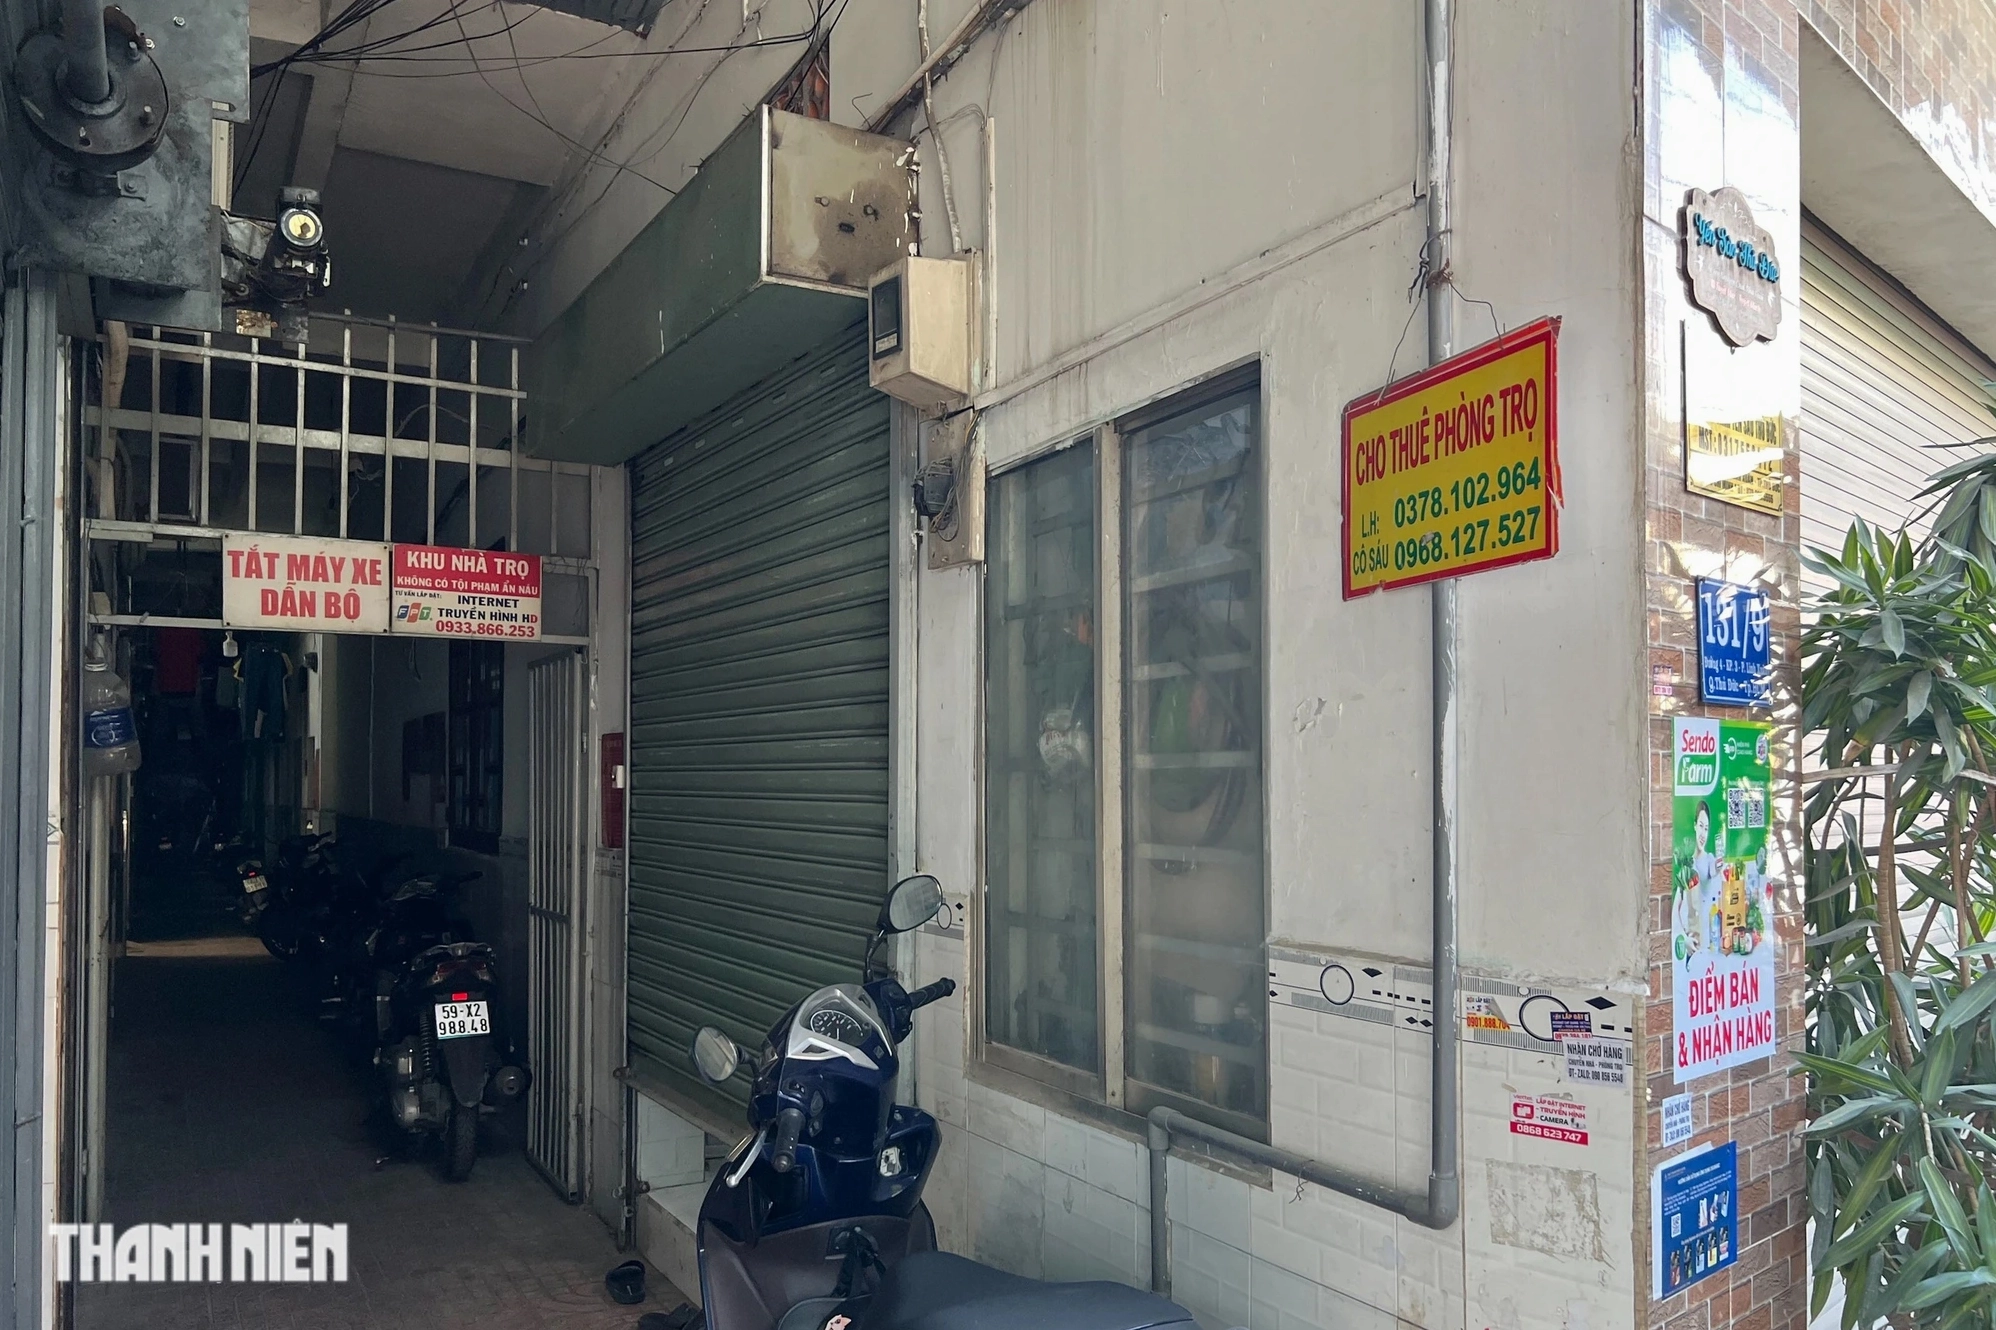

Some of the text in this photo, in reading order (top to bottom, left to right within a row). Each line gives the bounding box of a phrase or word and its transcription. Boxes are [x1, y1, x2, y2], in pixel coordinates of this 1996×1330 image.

[1356, 378, 1538, 486] CHO THUÊ PHÒNG TRỌ
[1361, 456, 1541, 538] L.H: 0378.102.964
[1353, 505, 1541, 576] CÔ SÁU 0968.127.527
[227, 544, 382, 586] TẮT MÁY XE
[407, 551, 529, 580] KHU NHÀ TRỌ
[397, 574, 538, 595] KHÔNG CÓ TỘI PHẠM ẨN NÁU
[261, 581, 361, 624] DẪN BỘ
[457, 595, 520, 608] INTERNET
[397, 603, 538, 624] FPT TRUYỀN HÌNH HD
[436, 620, 535, 638] 0933.866.253
[1700, 593, 1765, 659] 131/9
[1682, 729, 1715, 753] Sendo
[1681, 757, 1712, 783] Farm
[1689, 960, 1759, 1018] ĐIỂM BÁN
[442, 1003, 481, 1019] 59-X2
[439, 1018, 487, 1035] 988.48
[1678, 1006, 1771, 1068] & NHẬN HÀNG
[1603, 1044, 1623, 1059] HÀNG
[1540, 1106, 1567, 1116] TRUYỀN
[1568, 1110, 1586, 1119] HÌNH
[1559, 1103, 1586, 1111] INTERNET
[1540, 1115, 1569, 1125] CAMERA
[1517, 1124, 1582, 1142] 0868 623 747
